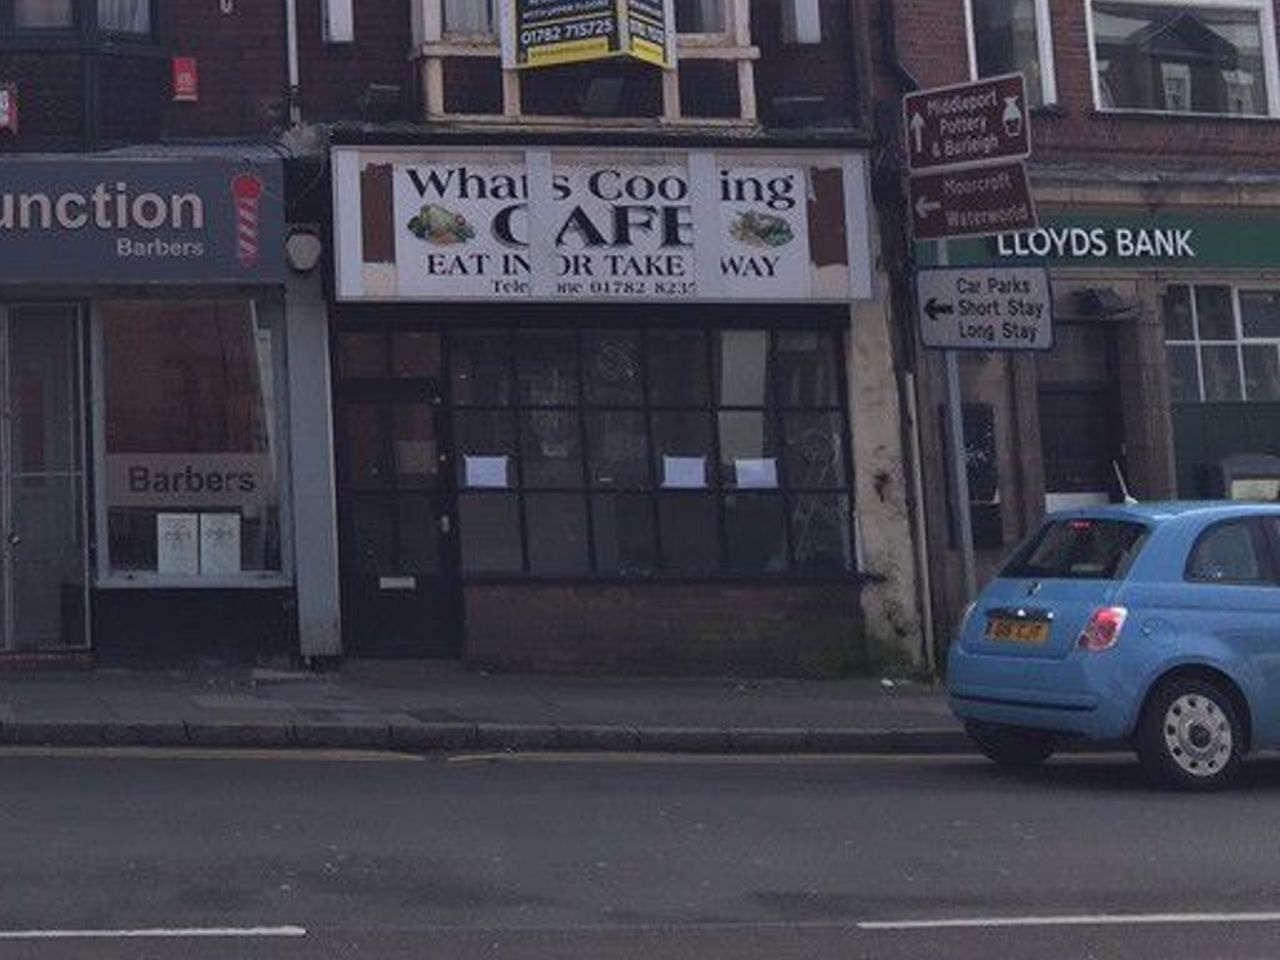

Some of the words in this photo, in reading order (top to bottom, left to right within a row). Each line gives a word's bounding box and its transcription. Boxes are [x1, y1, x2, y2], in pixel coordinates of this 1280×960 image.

[588, 167, 794, 210] Cooing
[117, 238, 203, 258] Barbers
[997, 229, 1107, 257] LLOYDS
[1117, 229, 1194, 256] BANK
[427, 254, 491, 276] EAT
[502, 254, 531, 276] IN
[603, 255, 685, 276] TAKE
[719, 255, 780, 277] WAY
[590, 280, 644, 295] 01782
[957, 277, 981, 295] Car
[988, 278, 1031, 295] Parks
[958, 299, 1000, 316] Short
[1008, 299, 1044, 319] Stay
[959, 322, 995, 341] Long
[1002, 322, 1037, 341] Stay
[129, 467, 255, 494] Barbers
